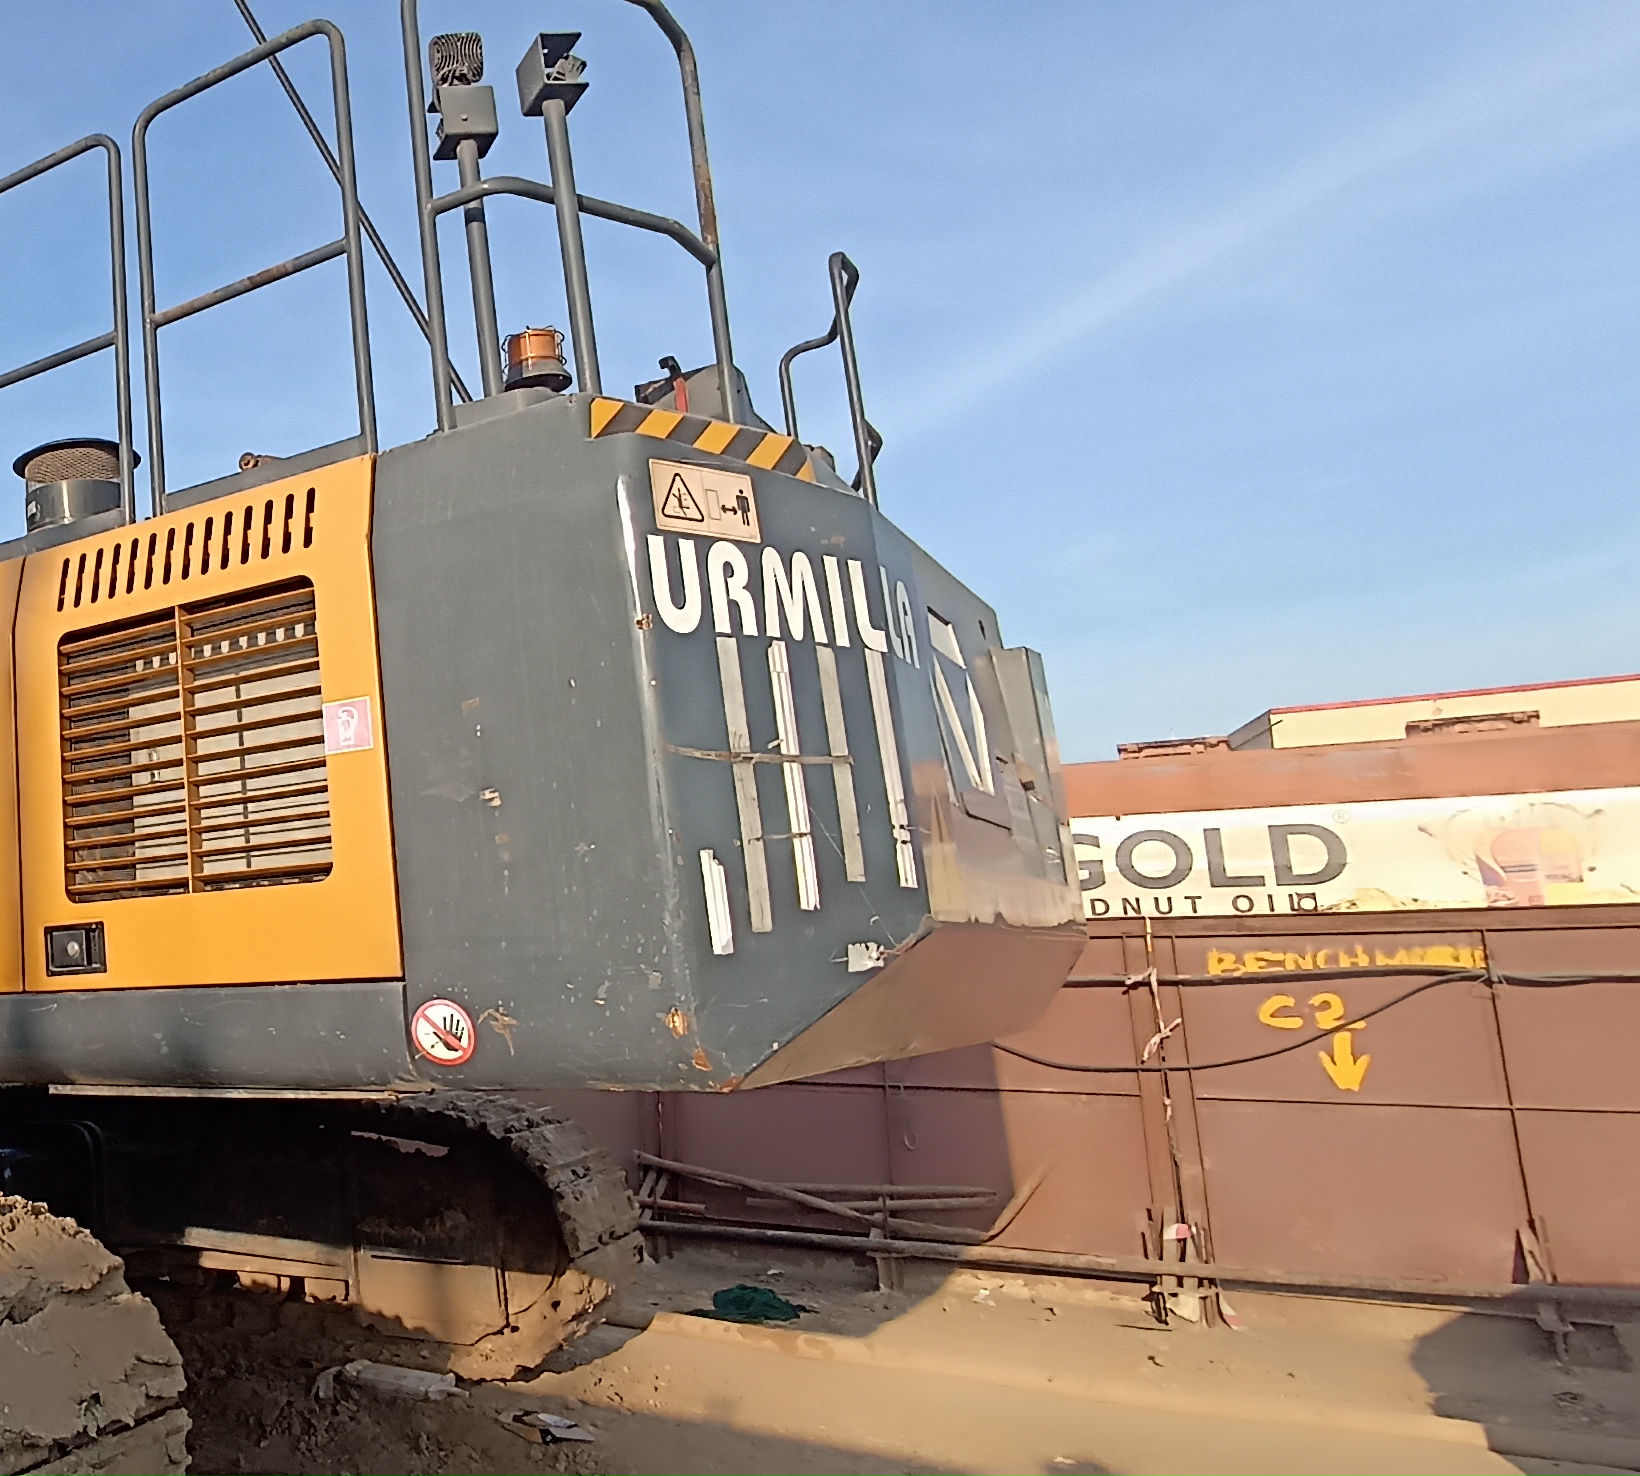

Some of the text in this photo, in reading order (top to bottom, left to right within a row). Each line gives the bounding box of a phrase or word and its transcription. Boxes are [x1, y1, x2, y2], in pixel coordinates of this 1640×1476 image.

[647, 534, 921, 670] URMILLA
[1072, 823, 1348, 892] GOLD
[1258, 991, 1367, 1030] C2
